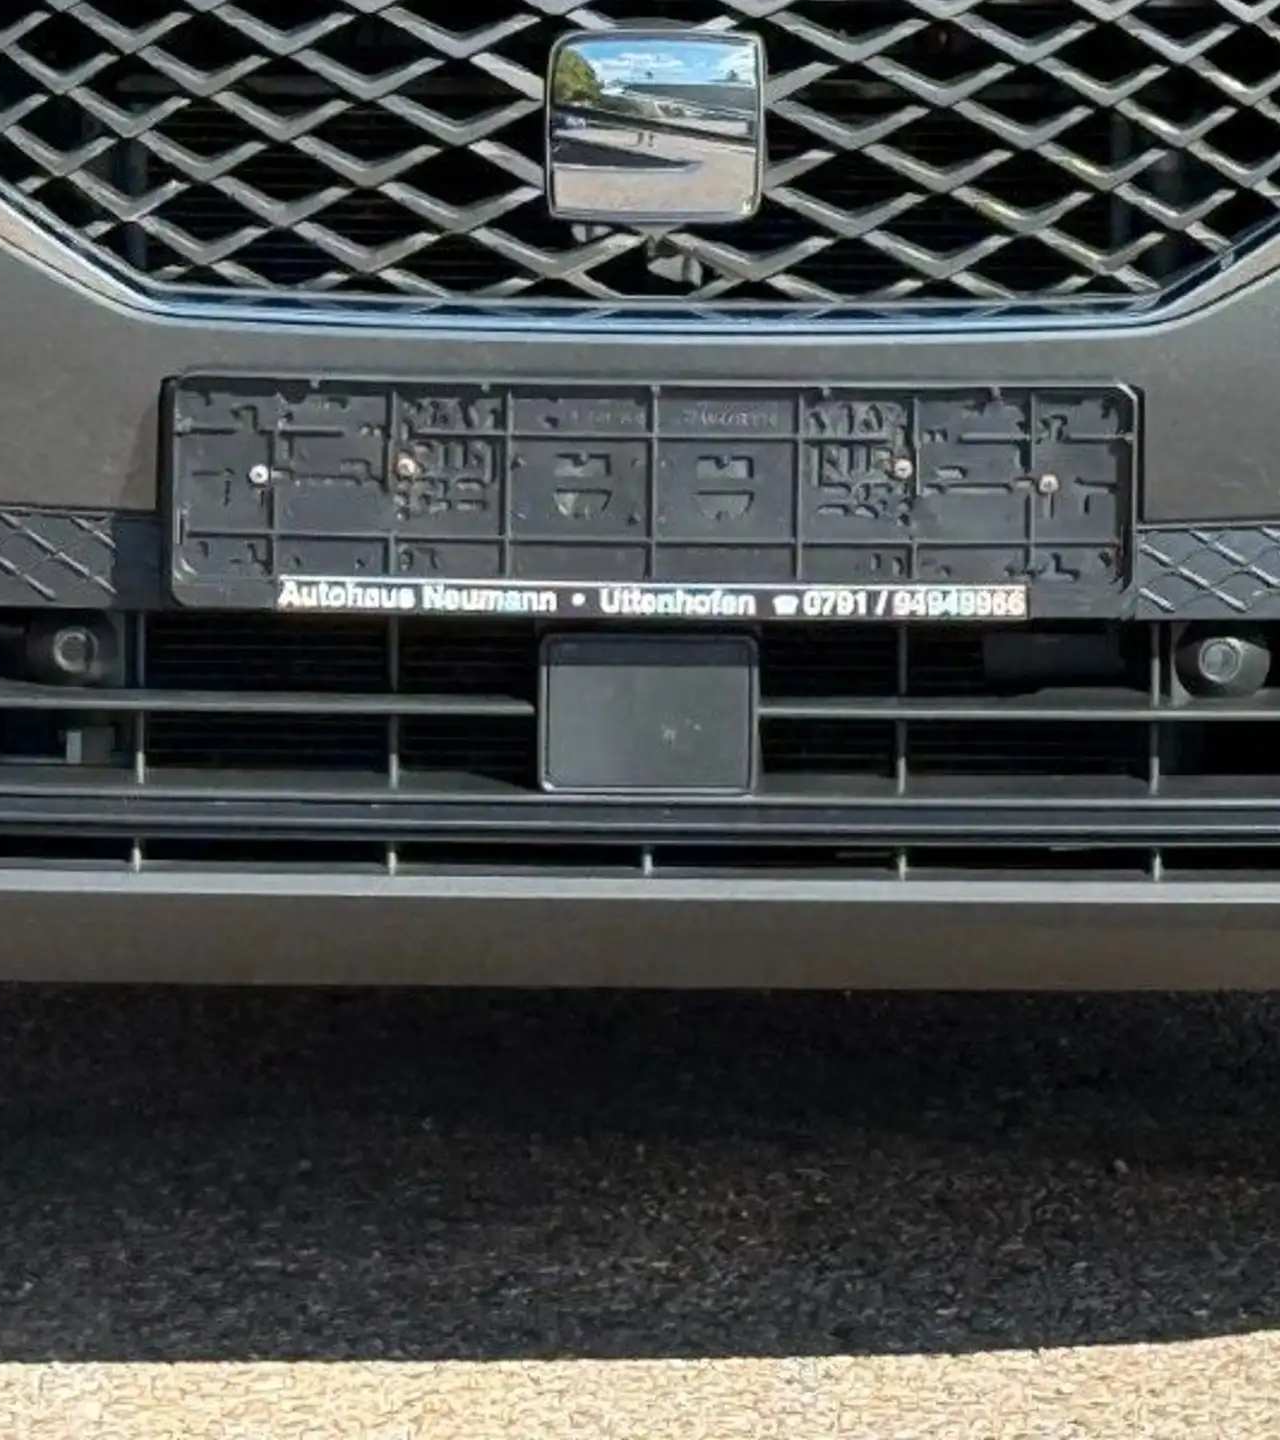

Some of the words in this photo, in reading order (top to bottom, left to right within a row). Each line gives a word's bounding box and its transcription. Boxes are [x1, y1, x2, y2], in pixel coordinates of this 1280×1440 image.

[278, 580, 416, 608] Autohaus
[422, 583, 558, 612] Neumann
[599, 586, 757, 616] Uttenhofen
[802, 589, 868, 617] 0791
